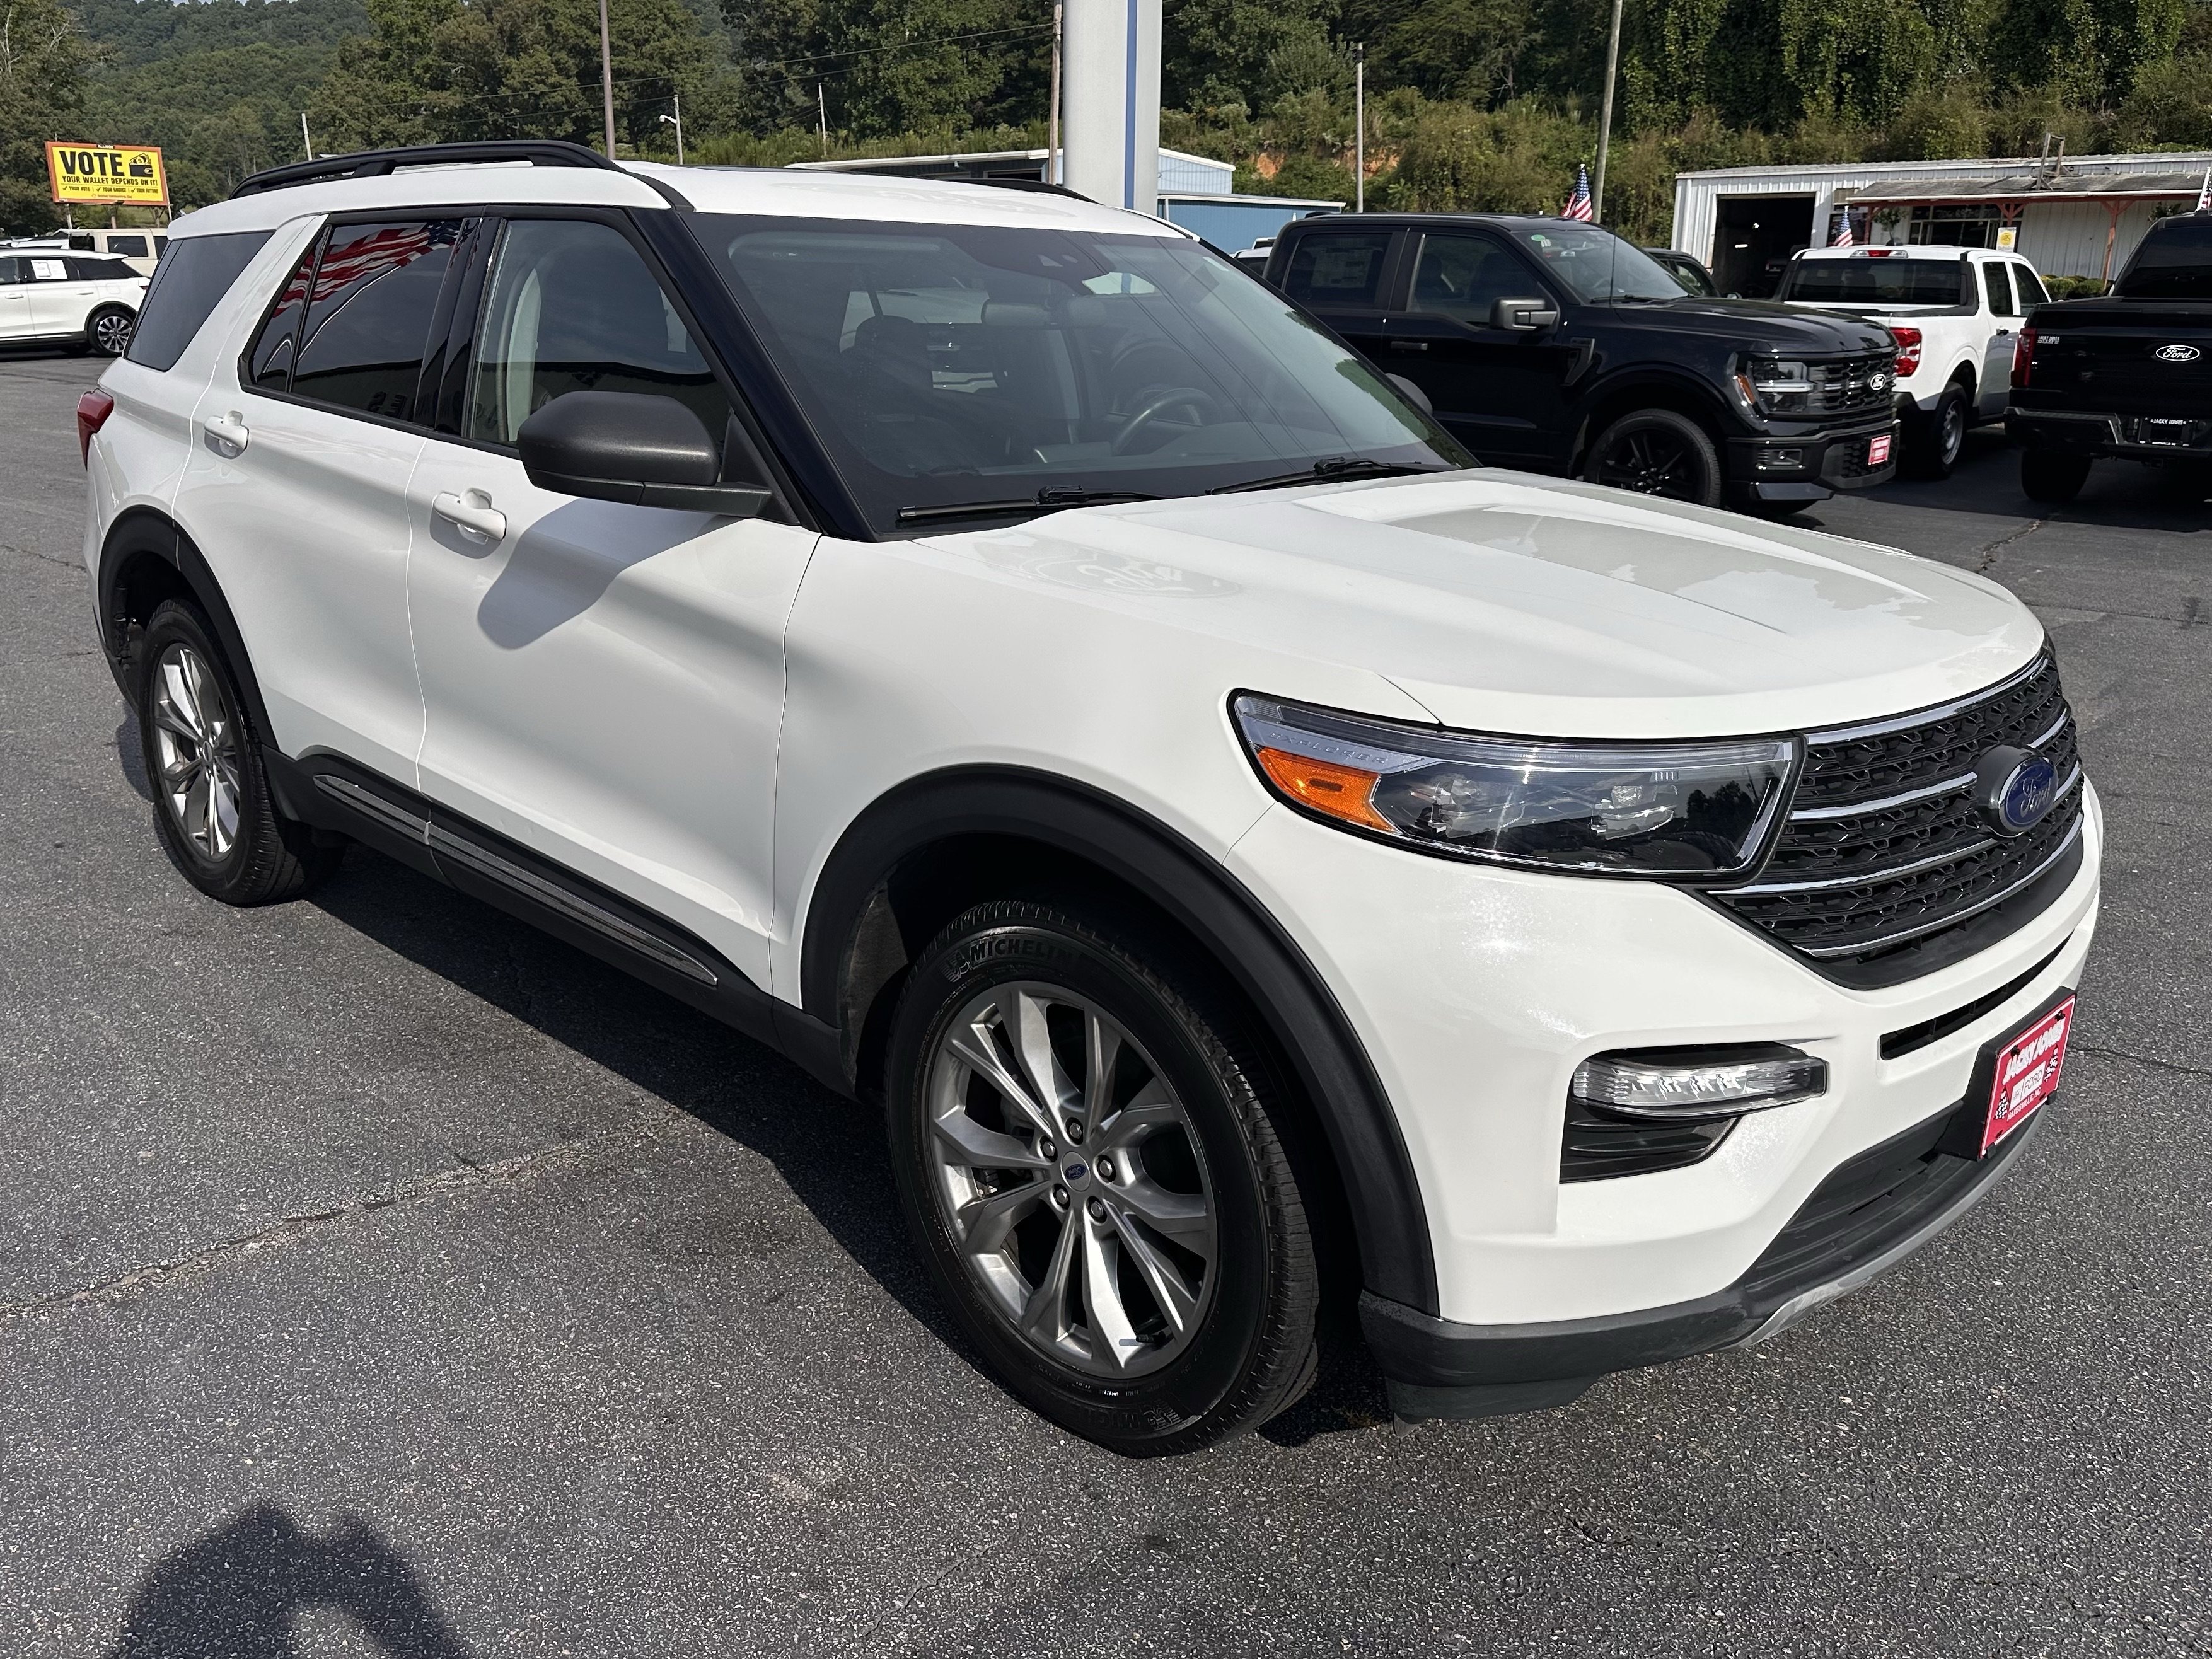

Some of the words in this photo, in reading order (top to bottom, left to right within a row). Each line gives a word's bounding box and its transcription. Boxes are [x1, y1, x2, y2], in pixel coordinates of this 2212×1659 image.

[59, 151, 125, 176] VOTE
[62, 175, 81, 183] YOUR
[83, 176, 108, 185] WALLET
[111, 178, 138, 186] DEPENDS
[2163, 347, 2192, 359] Ford
[1268, 732, 1389, 765] EXPLORER
[2020, 772, 2052, 818] Ford
[970, 939, 1072, 962] MICHELIN
[2002, 1038, 2037, 1085] JACKY
[2034, 1019, 2065, 1061] JONES
[2024, 1069, 2043, 1092] FORD
